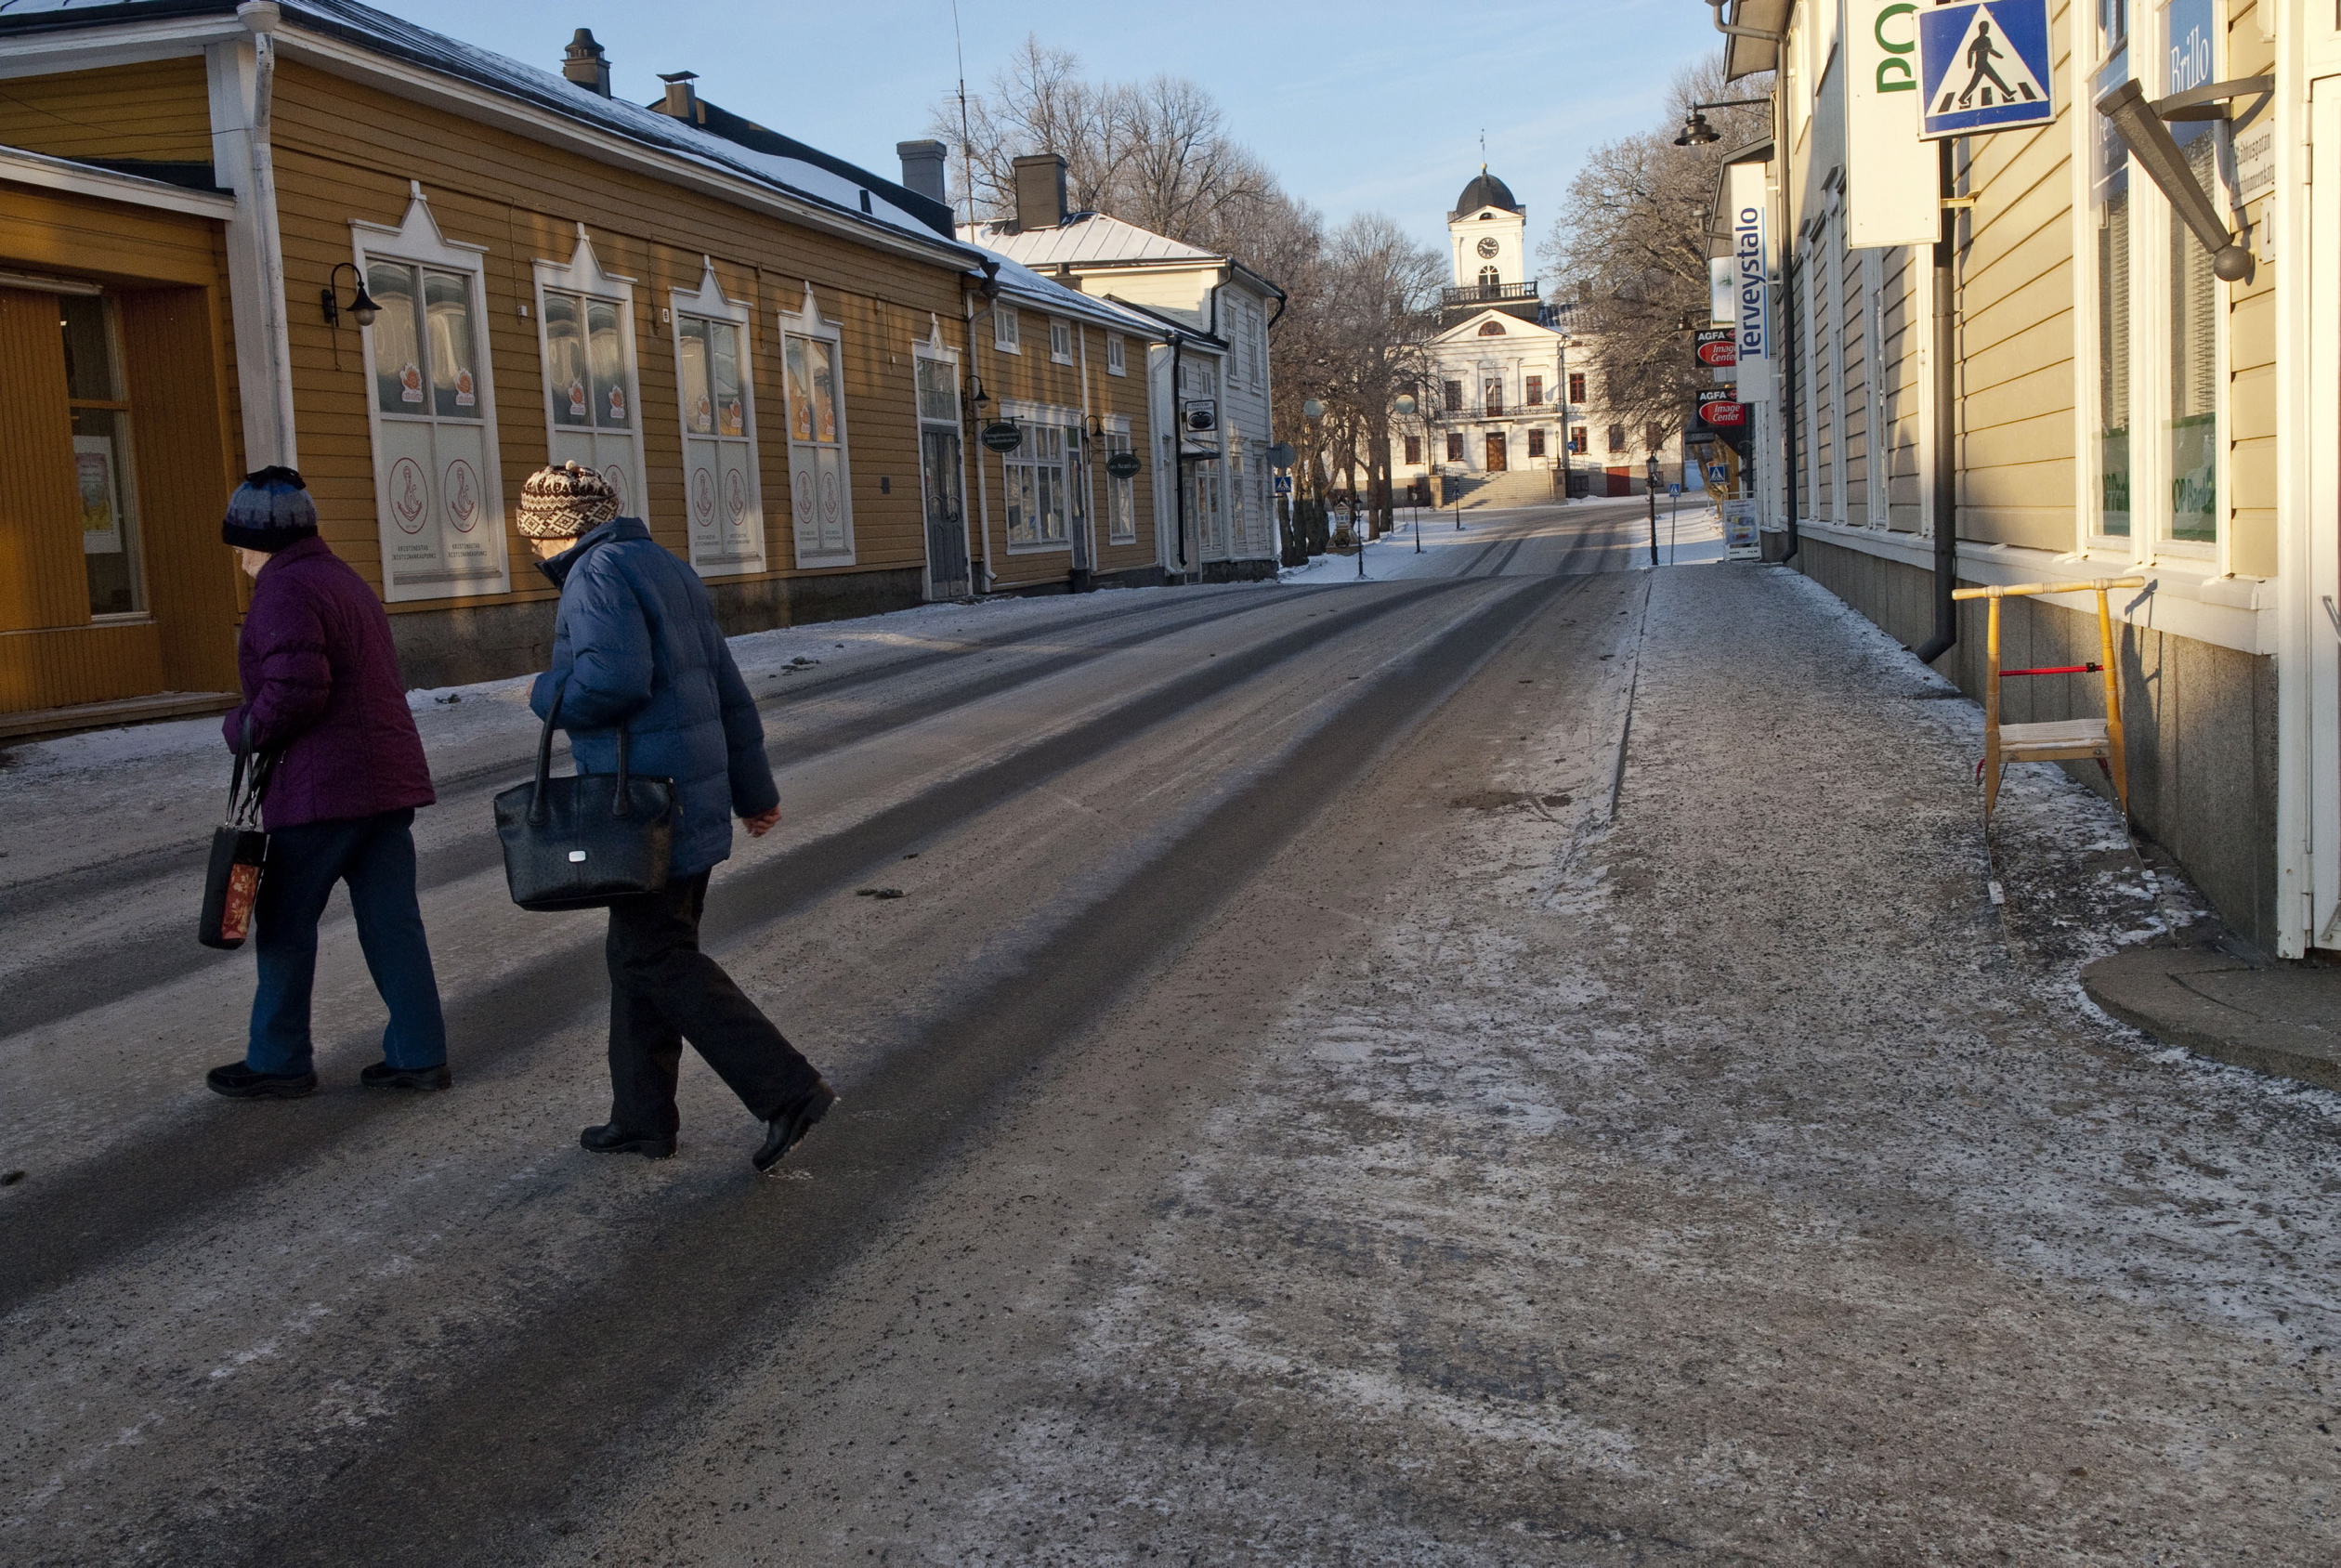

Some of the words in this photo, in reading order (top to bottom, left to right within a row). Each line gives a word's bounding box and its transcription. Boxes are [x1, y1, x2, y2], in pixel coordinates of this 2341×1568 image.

[2170, 23, 2210, 95] Brillo
[2266, 211, 2272, 244] 1
[1735, 207, 1767, 361] Terveystalo
[1698, 332, 1725, 341] AGFA
[1699, 391, 1727, 400] AGFA
[1714, 404, 1741, 413] Image
[1712, 412, 1739, 422] Center
